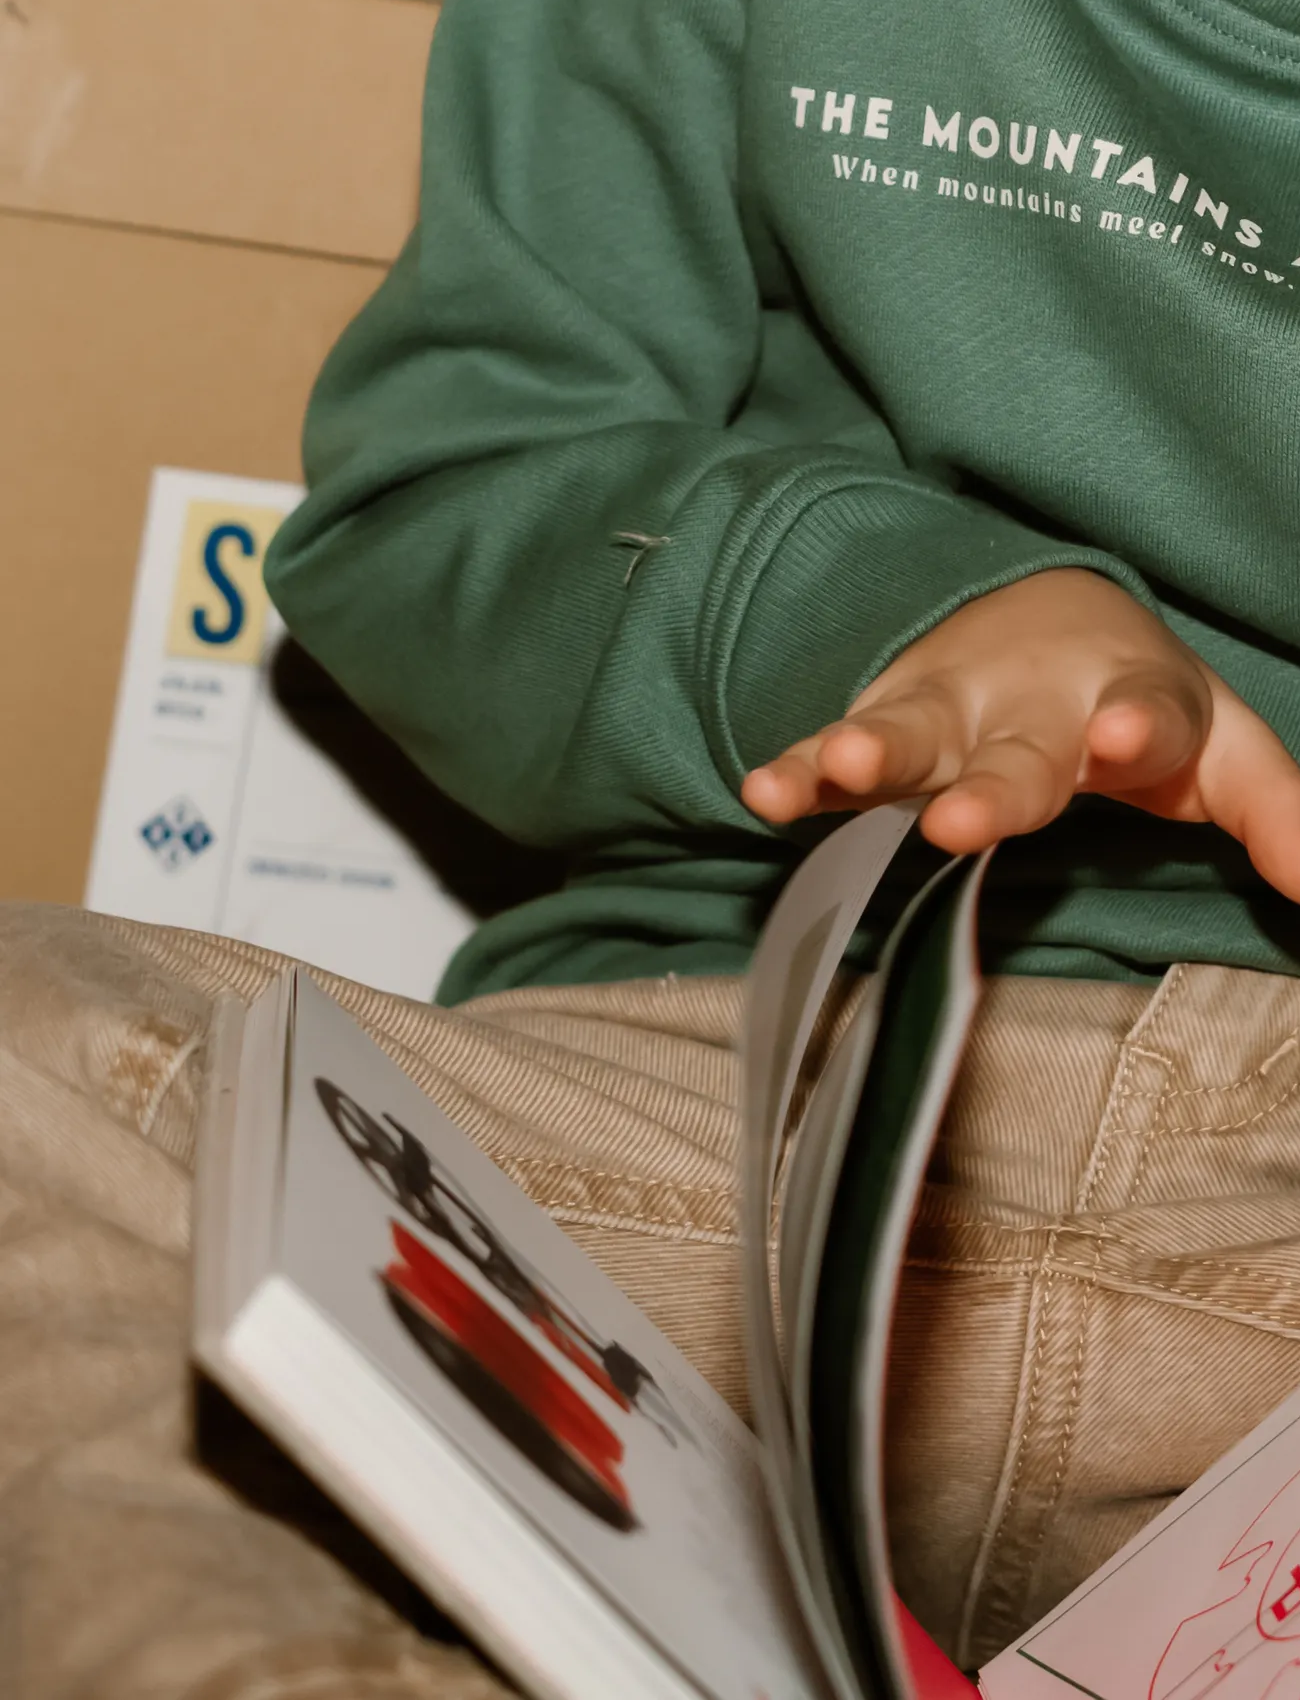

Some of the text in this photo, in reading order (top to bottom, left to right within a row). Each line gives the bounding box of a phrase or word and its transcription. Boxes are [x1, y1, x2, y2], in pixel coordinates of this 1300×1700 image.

[790, 86, 893, 140] THE
[922, 105, 1263, 248] MOUNTAINS
[832, 153, 920, 191] When
[938, 176, 1083, 224] mountains
[1099, 210, 1184, 245] meet
[191, 523, 256, 646] S
